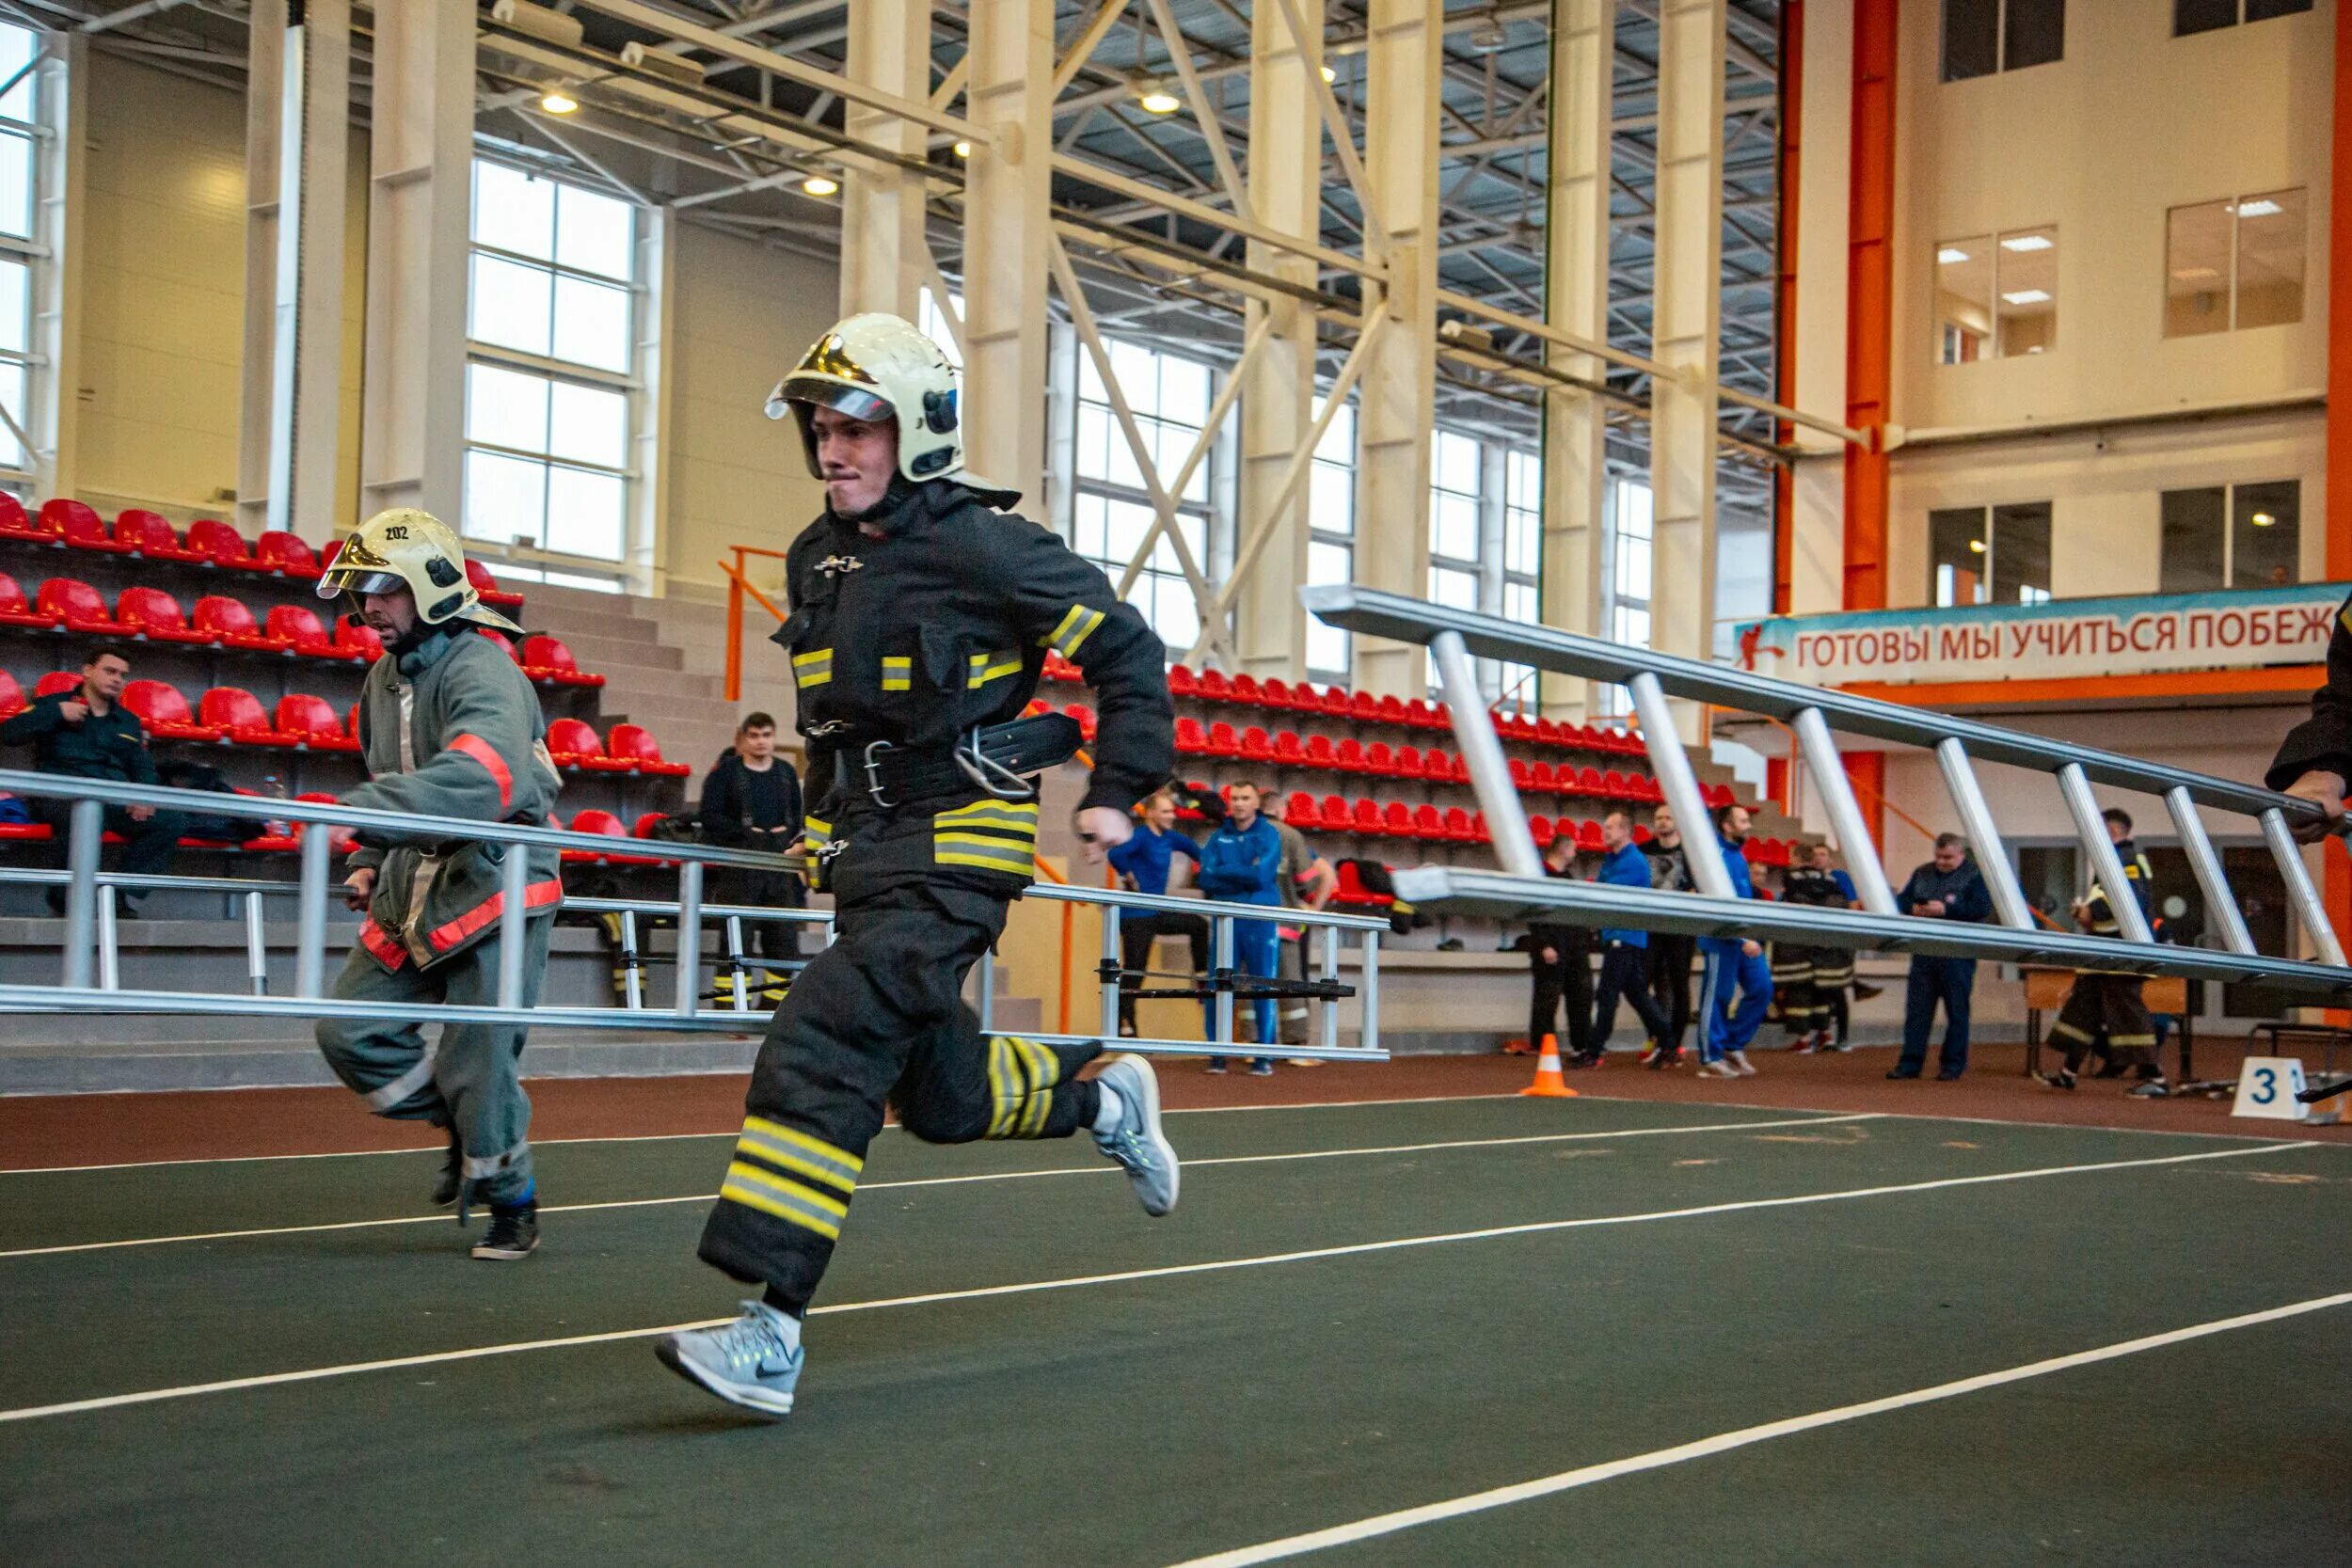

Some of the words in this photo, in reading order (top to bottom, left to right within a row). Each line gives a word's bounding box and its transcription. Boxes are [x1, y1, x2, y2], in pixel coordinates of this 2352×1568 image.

[386, 526, 409, 541] 202
[1798, 629, 1929, 668] ГОТОВЫ
[1940, 626, 2000, 661] МЫ
[2010, 615, 2176, 658] УЧИТЬСЯ
[2250, 1067, 2277, 1105] 3
